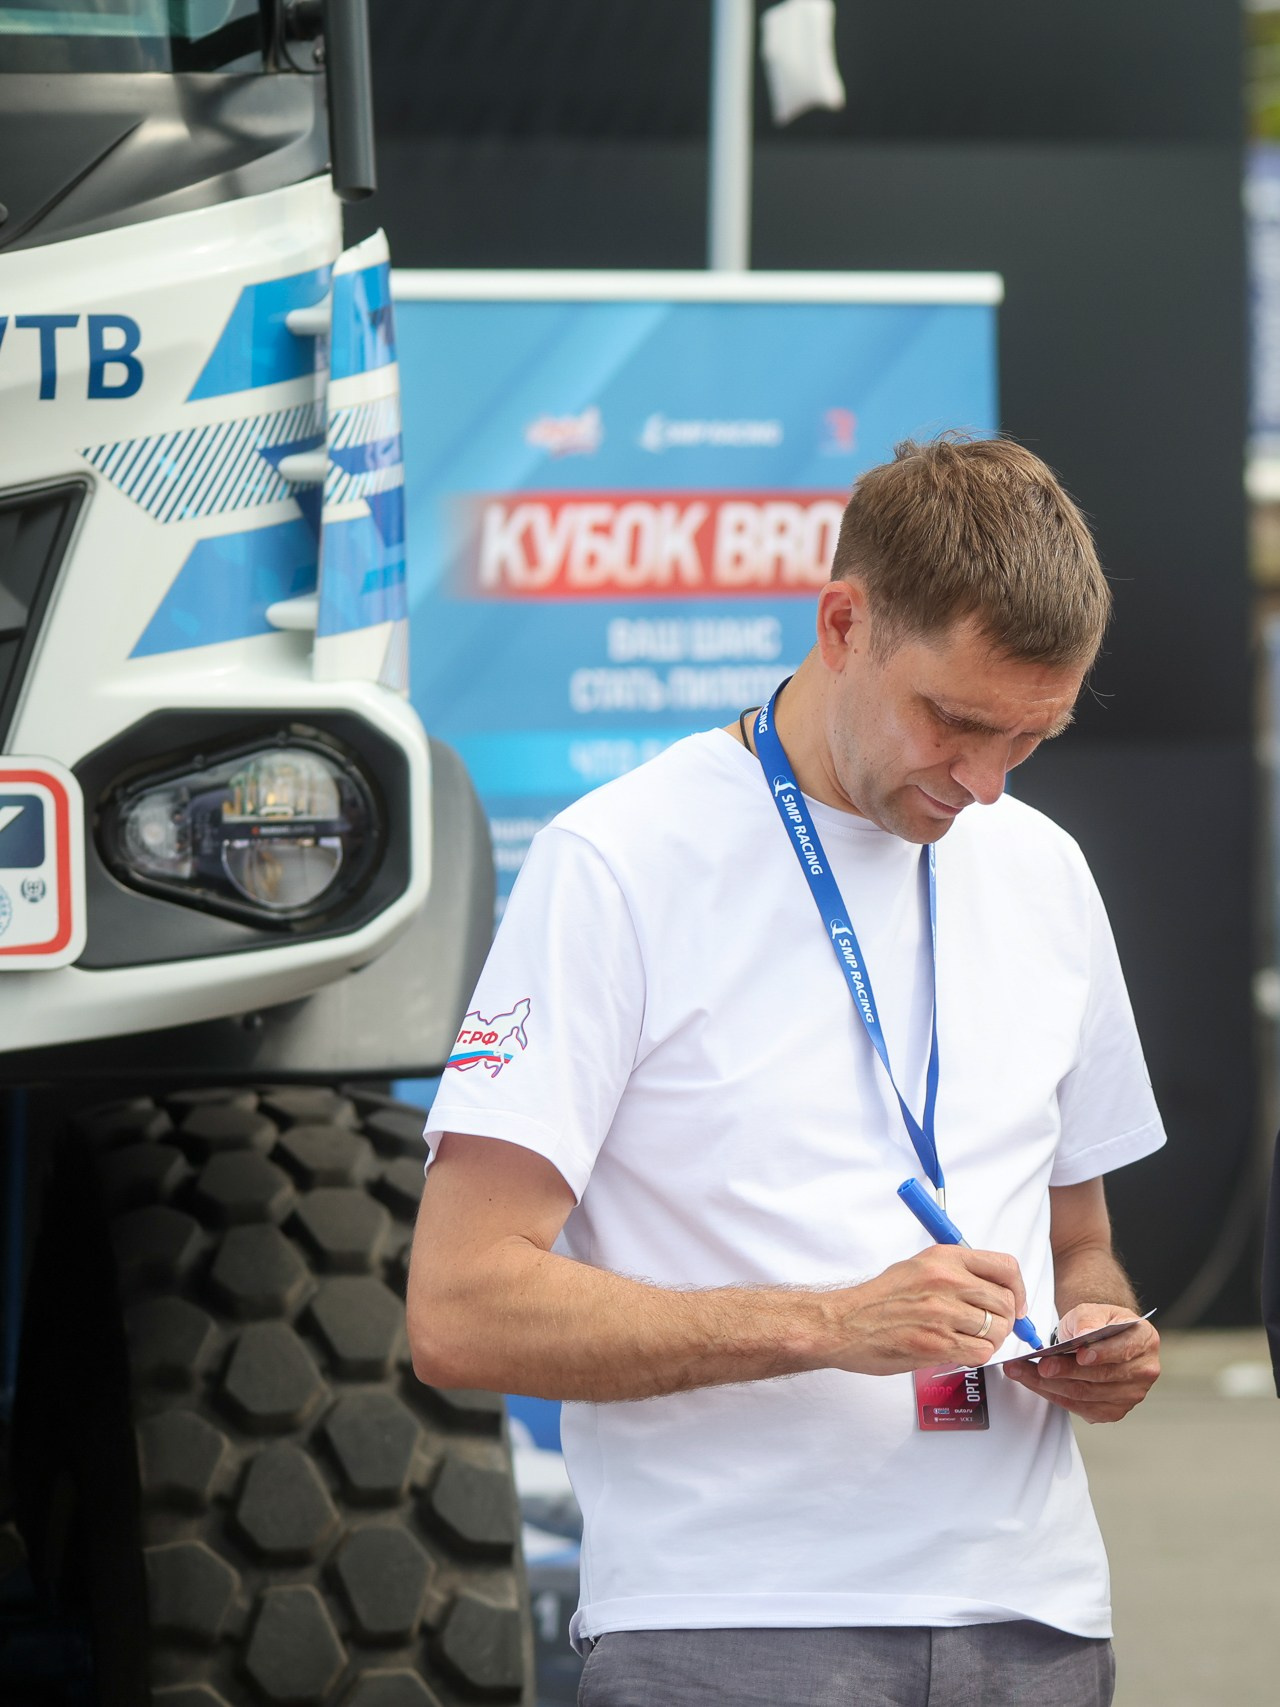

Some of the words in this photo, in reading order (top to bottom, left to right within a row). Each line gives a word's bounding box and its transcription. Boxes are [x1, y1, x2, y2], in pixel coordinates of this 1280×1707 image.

[0, 313, 144, 400] TB
[479, 501, 709, 589] КУБОК
[781, 794, 803, 824] SMP
[794, 824, 823, 875] RACING
[838, 938, 858, 969] SMP
[850, 969, 875, 1024] RACING
[964, 1367, 981, 1403] ОРГА
